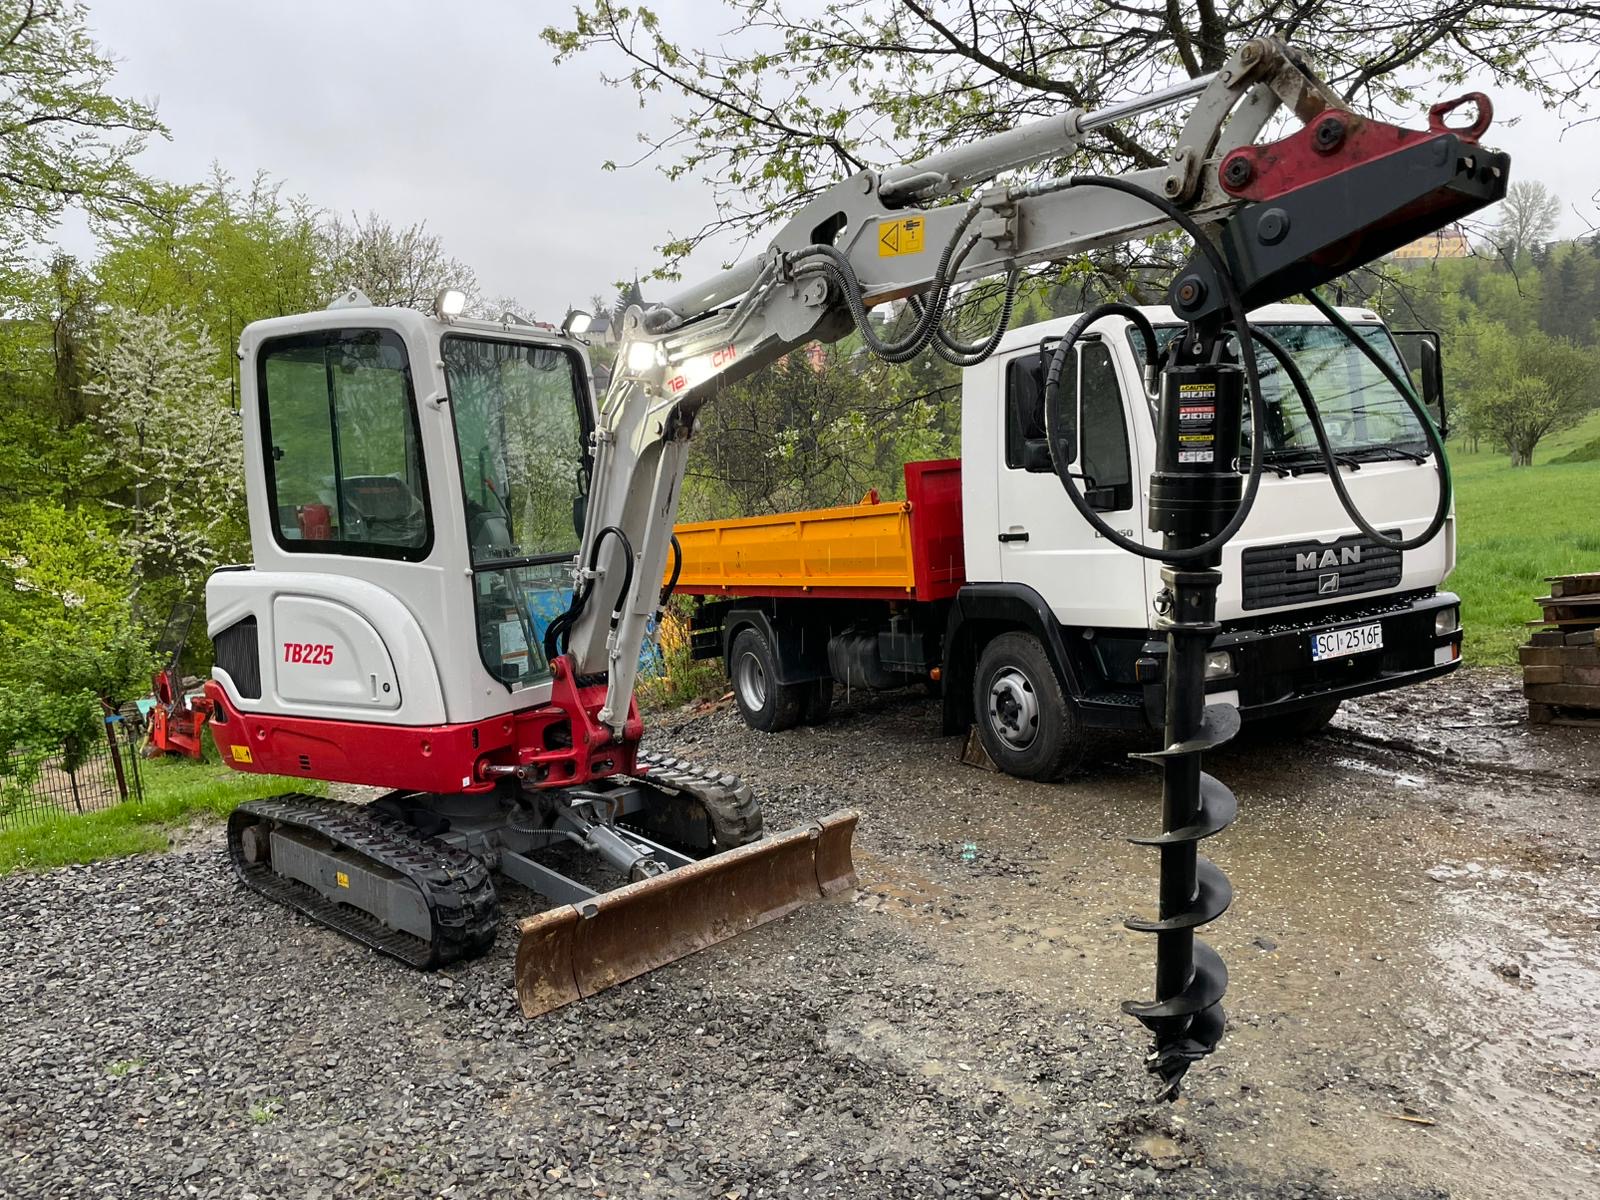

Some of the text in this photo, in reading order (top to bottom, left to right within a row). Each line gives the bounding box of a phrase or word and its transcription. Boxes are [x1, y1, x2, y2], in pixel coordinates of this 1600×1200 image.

[1295, 545, 1361, 572] MAN
[1318, 633, 1340, 654] SCI
[1345, 625, 1380, 649] 2516F
[283, 642, 335, 666] TB225
